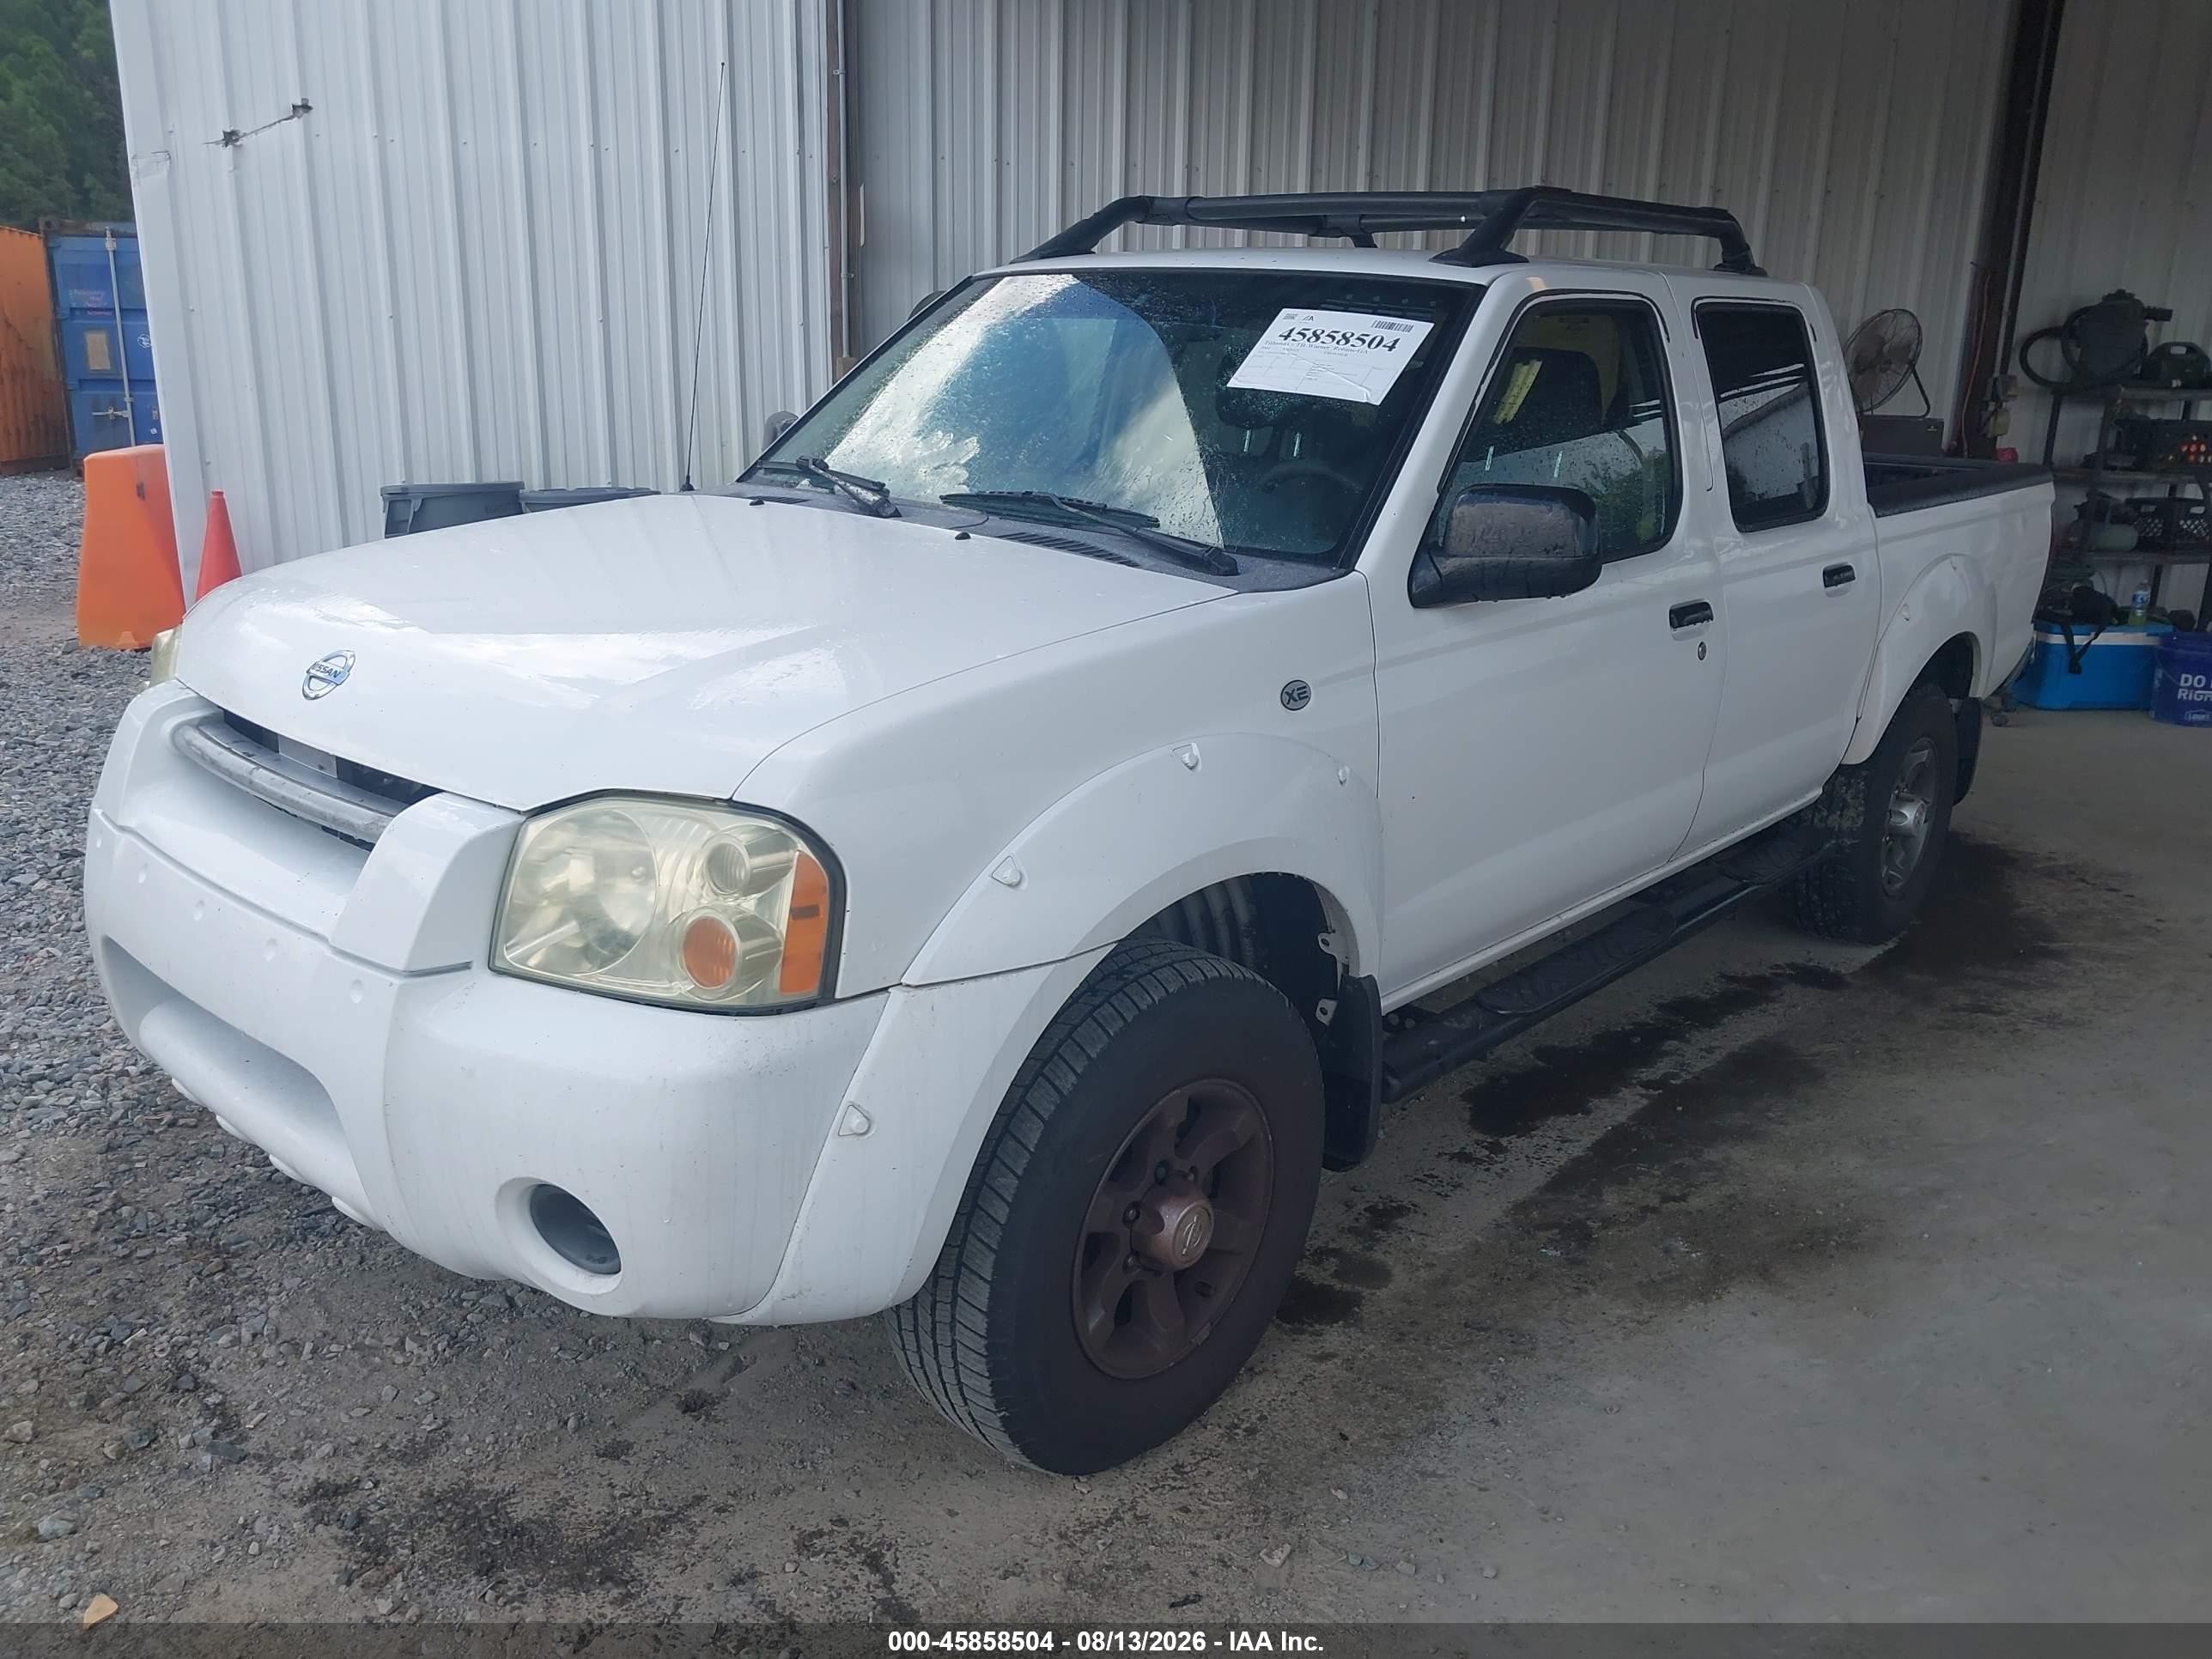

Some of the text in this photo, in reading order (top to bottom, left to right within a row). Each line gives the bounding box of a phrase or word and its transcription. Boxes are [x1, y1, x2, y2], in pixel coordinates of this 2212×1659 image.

[1279, 326, 1401, 352] 45858504
[2180, 673, 2206, 688] DO
[1285, 685, 1310, 705] XE
